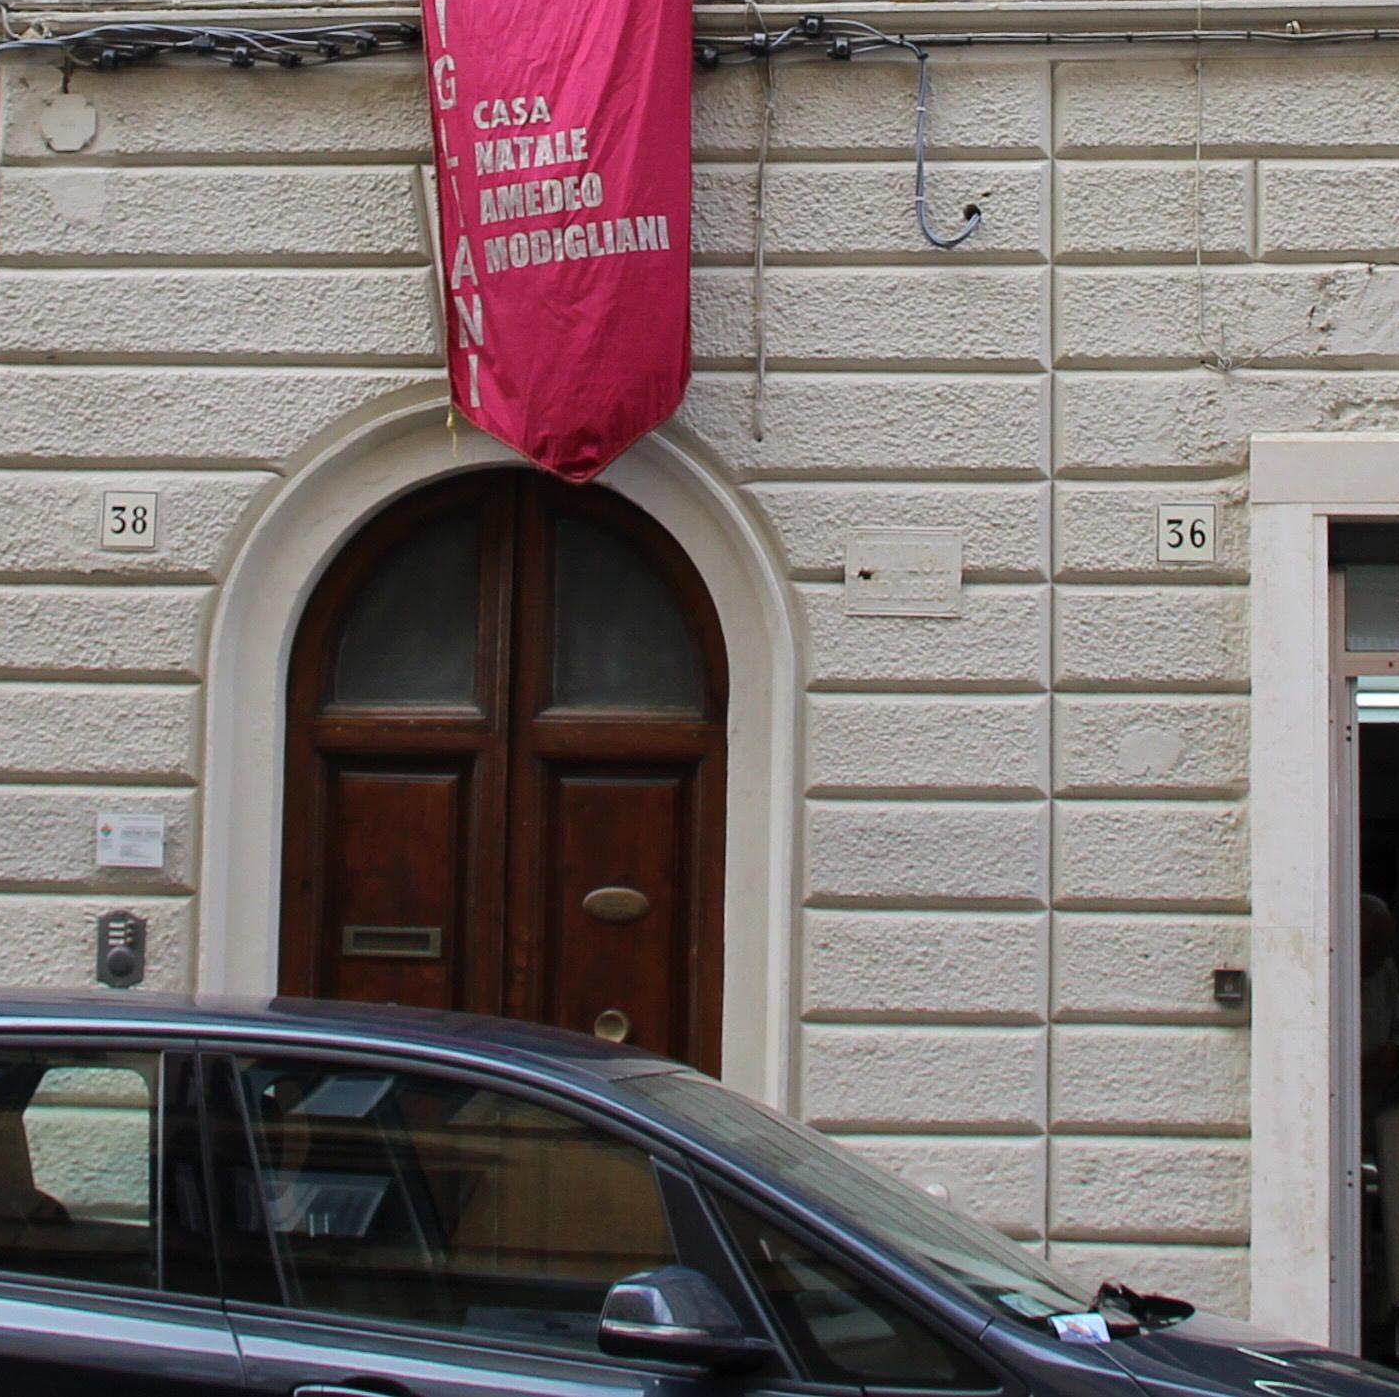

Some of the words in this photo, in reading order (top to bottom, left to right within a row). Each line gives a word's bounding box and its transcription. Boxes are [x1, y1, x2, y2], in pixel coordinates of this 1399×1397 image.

[472, 96, 550, 130] CASA
[474, 127, 588, 175] NATALE
[478, 172, 602, 225] AMEDEO
[485, 215, 670, 275] MODIGLIANI
[110, 505, 148, 534] 38
[1166, 519, 1206, 547] 36
